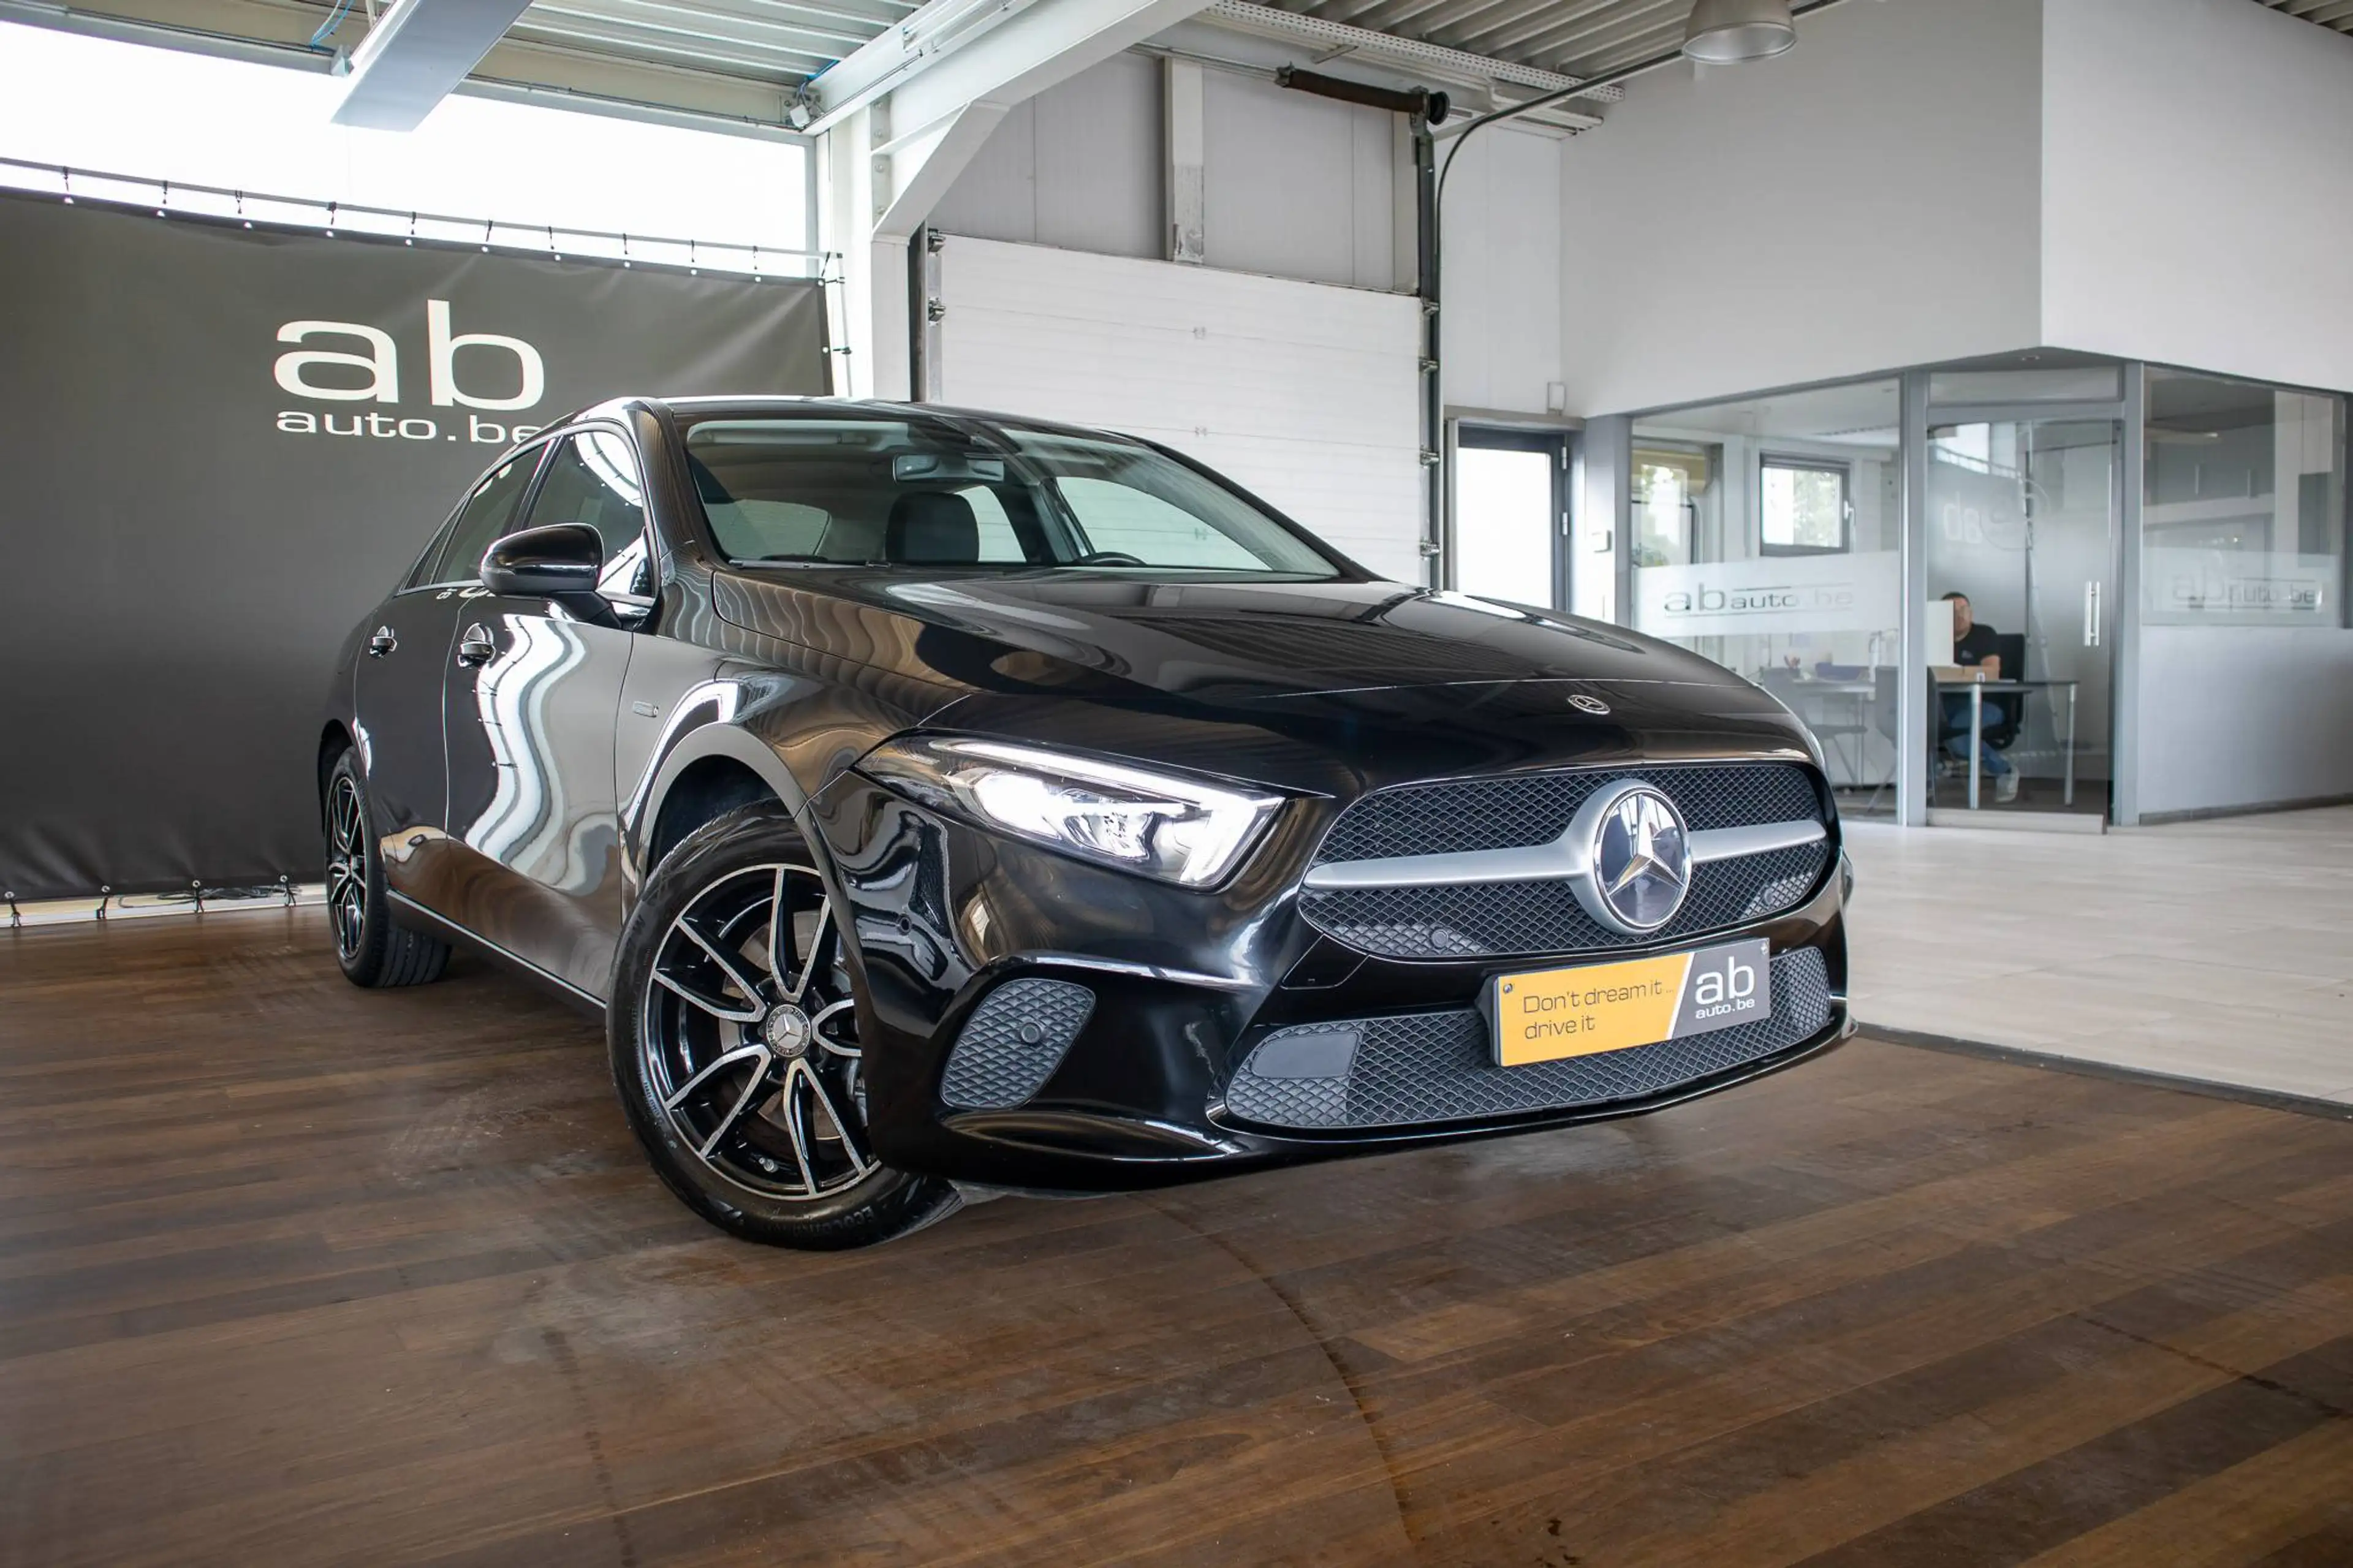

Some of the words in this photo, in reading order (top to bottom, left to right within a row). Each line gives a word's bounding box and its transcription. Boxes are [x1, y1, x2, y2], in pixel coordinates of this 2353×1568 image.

[273, 298, 545, 411] ab
[276, 411, 542, 444] auto.be
[1664, 582, 1726, 612] ab
[1730, 588, 1853, 610] autobe
[1695, 955, 1755, 1006] ab
[1523, 990, 1581, 1014] Don't
[1584, 985, 1647, 1006] dream
[1695, 998, 1756, 1020] auto.be
[1524, 1020, 1577, 1040] drive
[1581, 1015, 1596, 1032] it
